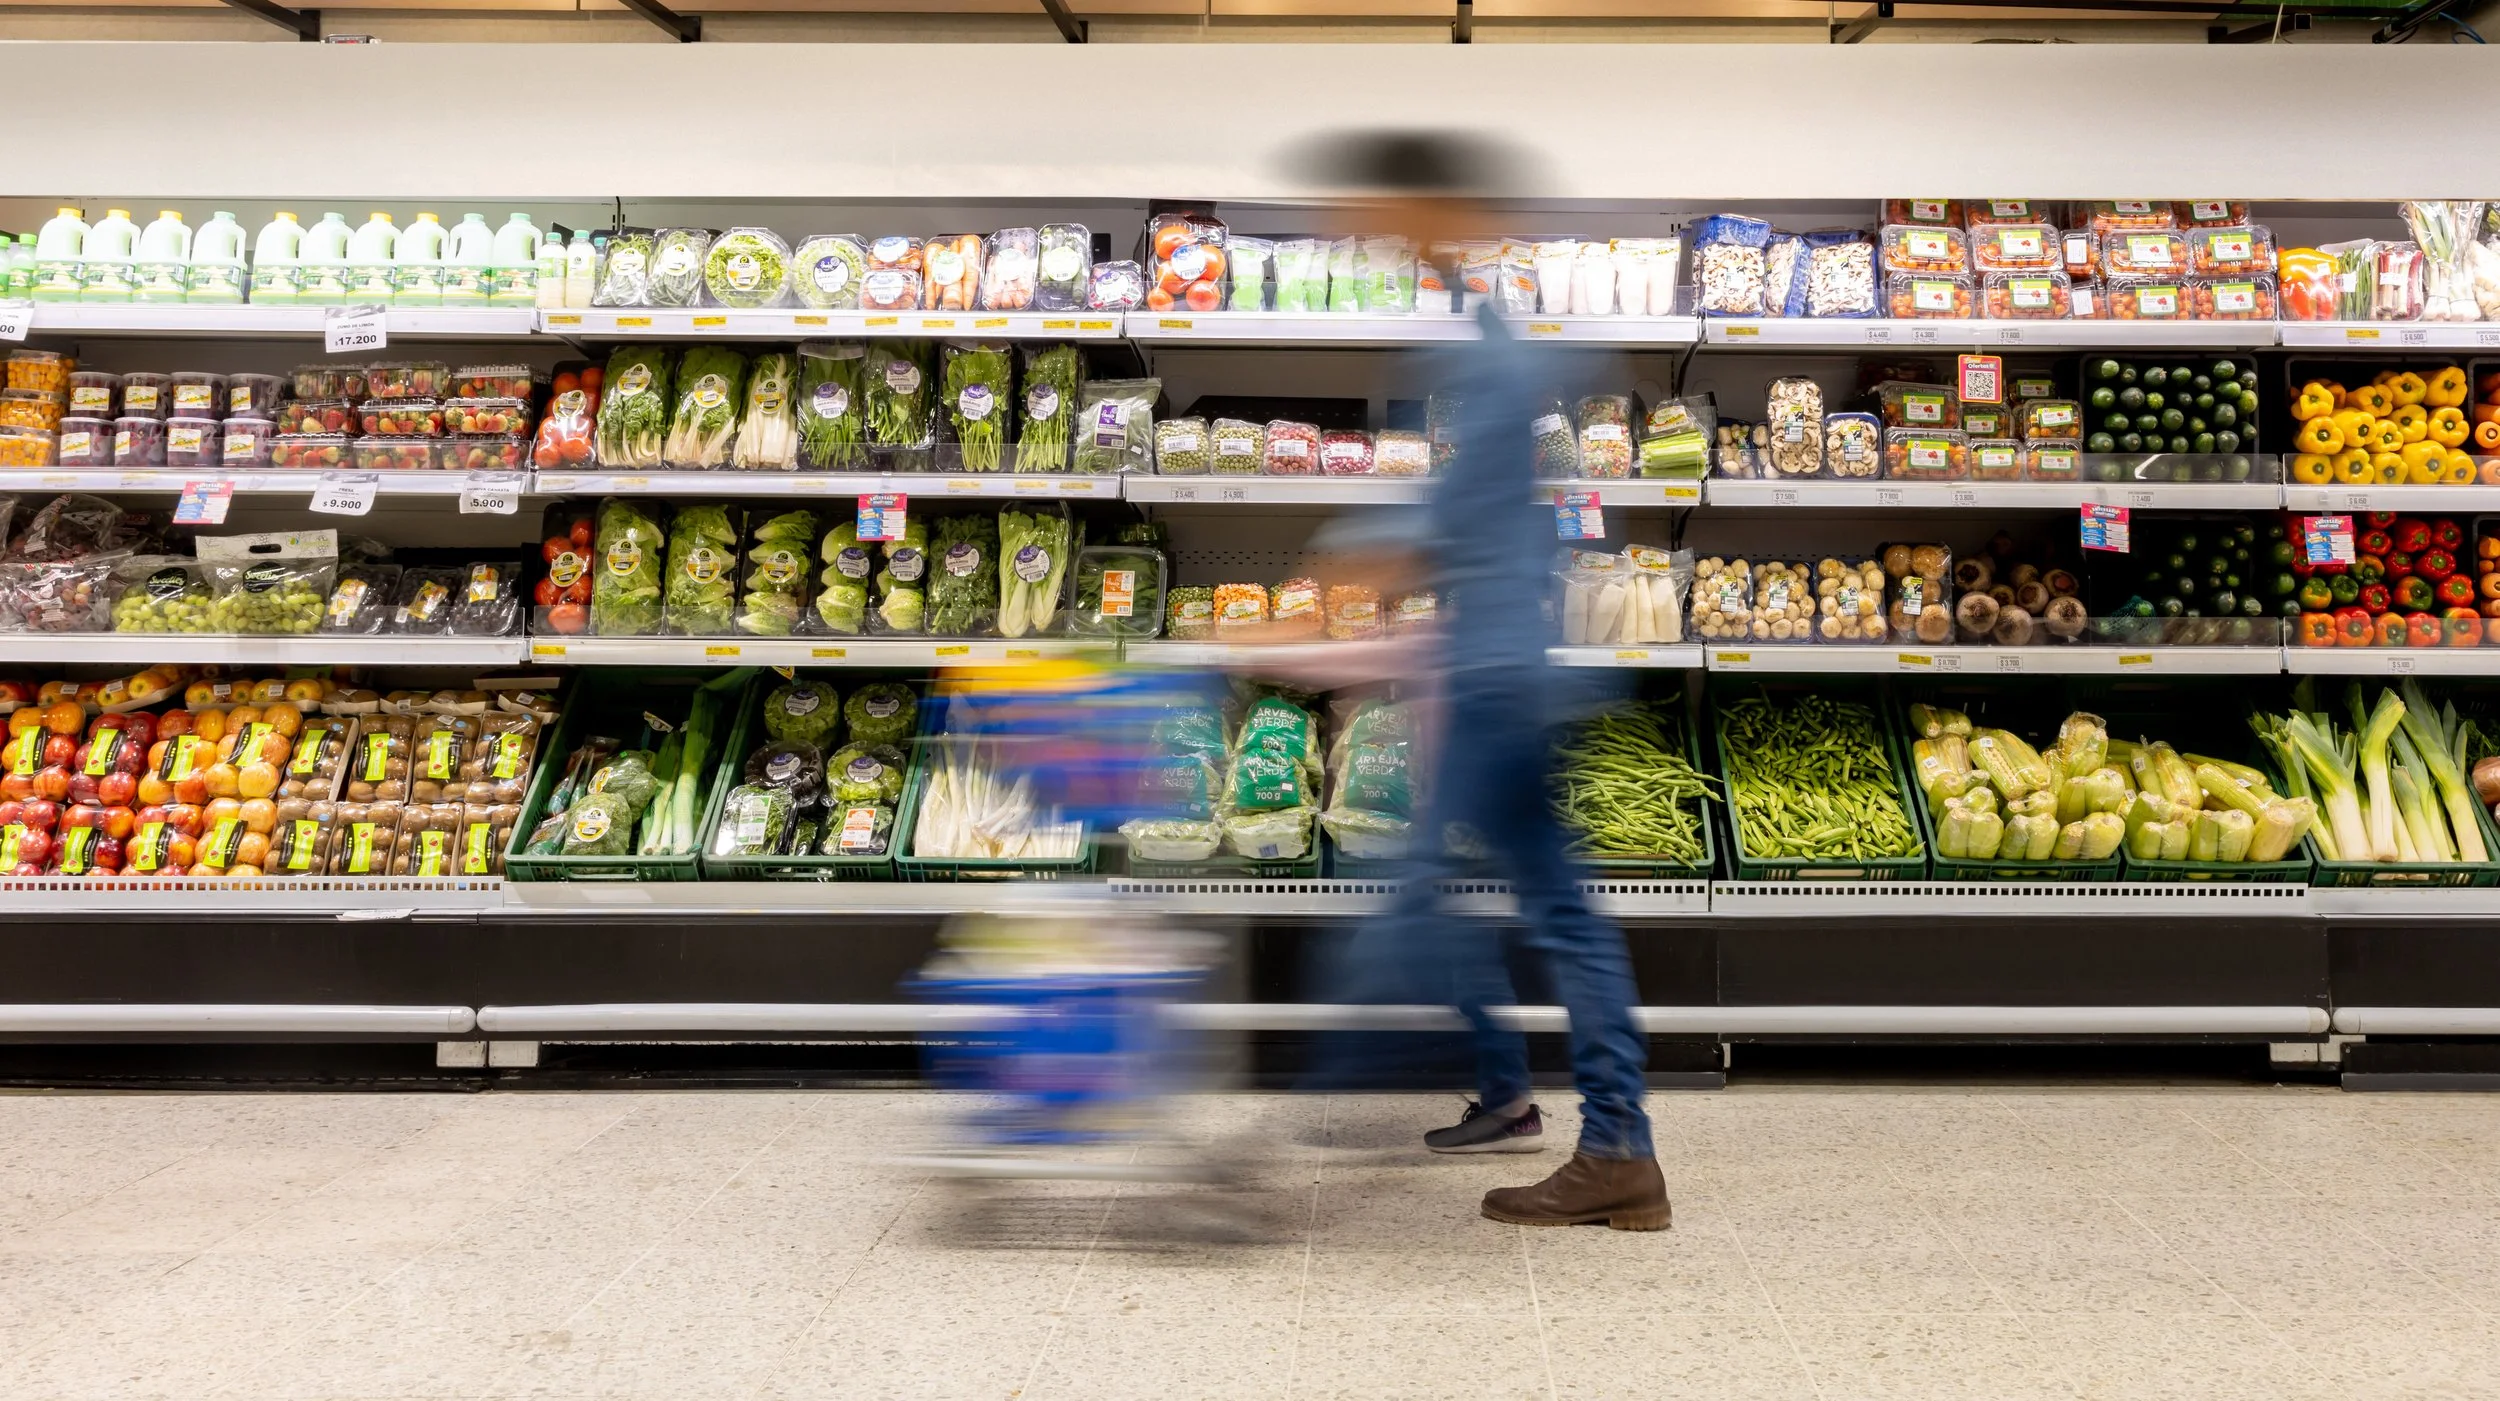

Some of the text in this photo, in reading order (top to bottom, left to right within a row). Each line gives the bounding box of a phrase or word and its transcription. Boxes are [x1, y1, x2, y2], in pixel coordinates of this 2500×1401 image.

[1256, 708, 1301, 720] ARVEJA
[1260, 717, 1296, 729] VERDE
[1262, 741, 1280, 749] 700
[1248, 767, 1285, 777] VERDE
[1357, 765, 1395, 776] VERDE
